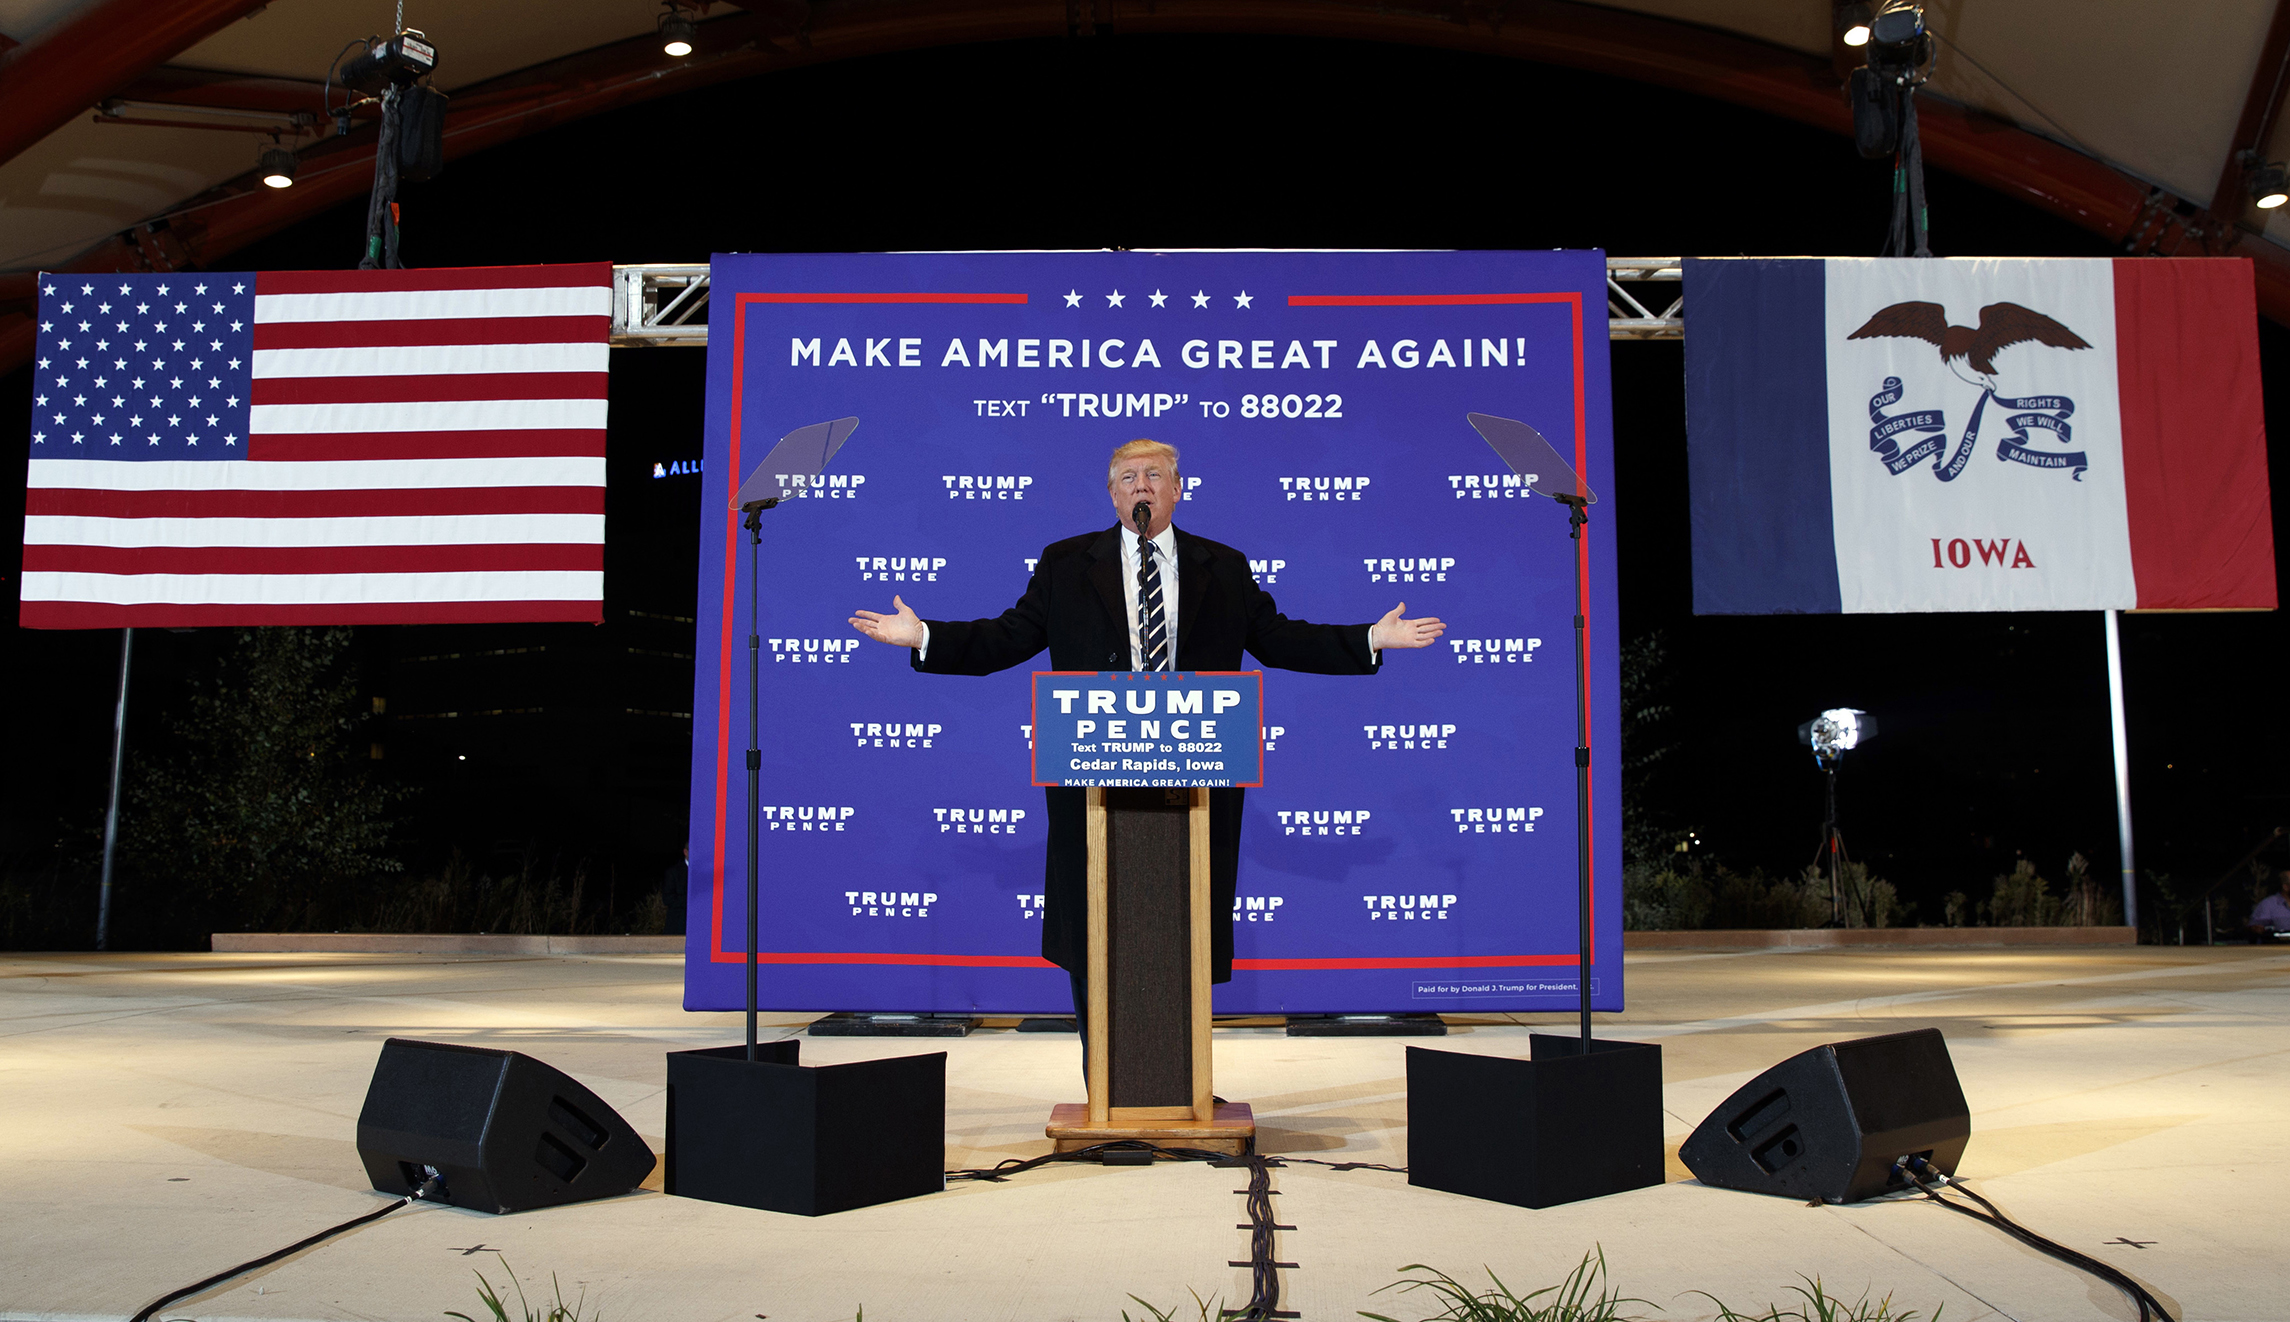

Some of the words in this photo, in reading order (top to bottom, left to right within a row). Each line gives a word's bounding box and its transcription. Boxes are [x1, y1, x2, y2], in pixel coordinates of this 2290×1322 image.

[791, 338, 921, 367] MAKE
[941, 338, 1162, 368] AMERICA
[1182, 340, 1338, 369] GREAT
[1357, 338, 1526, 369] AGAIN!
[973, 399, 1031, 417] TEXT
[1041, 393, 1189, 418] “TRUMP”
[1199, 401, 1230, 418] TO
[1240, 393, 1343, 418] 88022
[1873, 393, 1897, 407] OUR
[2016, 398, 2061, 408] RIGHTS
[1874, 414, 1933, 440] LIBERTIES
[2016, 416, 2035, 427] WE
[2037, 416, 2063, 433] WILL
[1891, 457, 1909, 472] WE
[1906, 440, 1938, 464] PRIZE
[1948, 455, 1967, 478] AND
[1961, 431, 1976, 456] OUR
[2008, 448, 2067, 467] MAINTAIN
[775, 474, 866, 488] TRUMP
[943, 476, 1032, 490] TRUMP
[1280, 477, 1370, 490] TRUMP
[1448, 474, 1539, 488] TRUMP
[782, 489, 856, 499] PENCE
[950, 491, 1023, 500] PENCE
[1287, 492, 1360, 500] PENCE
[1456, 489, 1530, 499] PENCE
[1930, 538, 2036, 569] IOWA
[856, 558, 946, 571] TRUMP
[1364, 558, 1455, 571] TRUMP
[864, 573, 936, 582] PENCE
[1372, 573, 1446, 582] PENCE
[769, 639, 859, 653] TRUMP
[1450, 638, 1541, 652] TRUMP
[776, 654, 849, 663] PENCE
[1458, 654, 1532, 663] PENCE
[1052, 690, 1241, 714] TRUMP
[851, 723, 941, 737] TRUMP
[1077, 720, 1217, 739] PENCE
[1364, 725, 1456, 738] TRUMP
[858, 739, 932, 748] PENCE
[1071, 742, 1097, 753] Text
[1102, 742, 1155, 753] TRUMP
[1160, 743, 1173, 753] to
[1178, 742, 1223, 753] 88022
[1372, 740, 1446, 749] PENCE
[1070, 758, 1117, 771] Cedar
[1122, 758, 1181, 773] Rapids,
[1186, 758, 1224, 771] Iowa
[1064, 778, 1095, 787] MAKE
[1098, 778, 1148, 787] AMERICA
[1152, 778, 1188, 787] GREAT
[1191, 778, 1230, 787] AGAIN!
[763, 807, 854, 821] TRUMP
[934, 809, 1025, 822] TRUMP
[1278, 811, 1370, 824] TRUMP
[1451, 808, 1543, 822] TRUMP
[771, 822, 844, 832] PENCE
[941, 824, 1015, 833] PENCE
[1286, 826, 1360, 835] PENCE
[1459, 823, 1534, 833] PENCE
[845, 892, 937, 906] TRUMP
[1364, 895, 1457, 909] TRUMP
[853, 907, 927, 917] PENCE
[1232, 912, 1274, 922] NCE
[1372, 911, 1447, 920] PENCE
[1418, 985, 1436, 993] Paid
[1438, 985, 1448, 993] for
[1450, 985, 1460, 994] by
[1498, 984, 1525, 992] Trump
[1526, 983, 1537, 991] for
